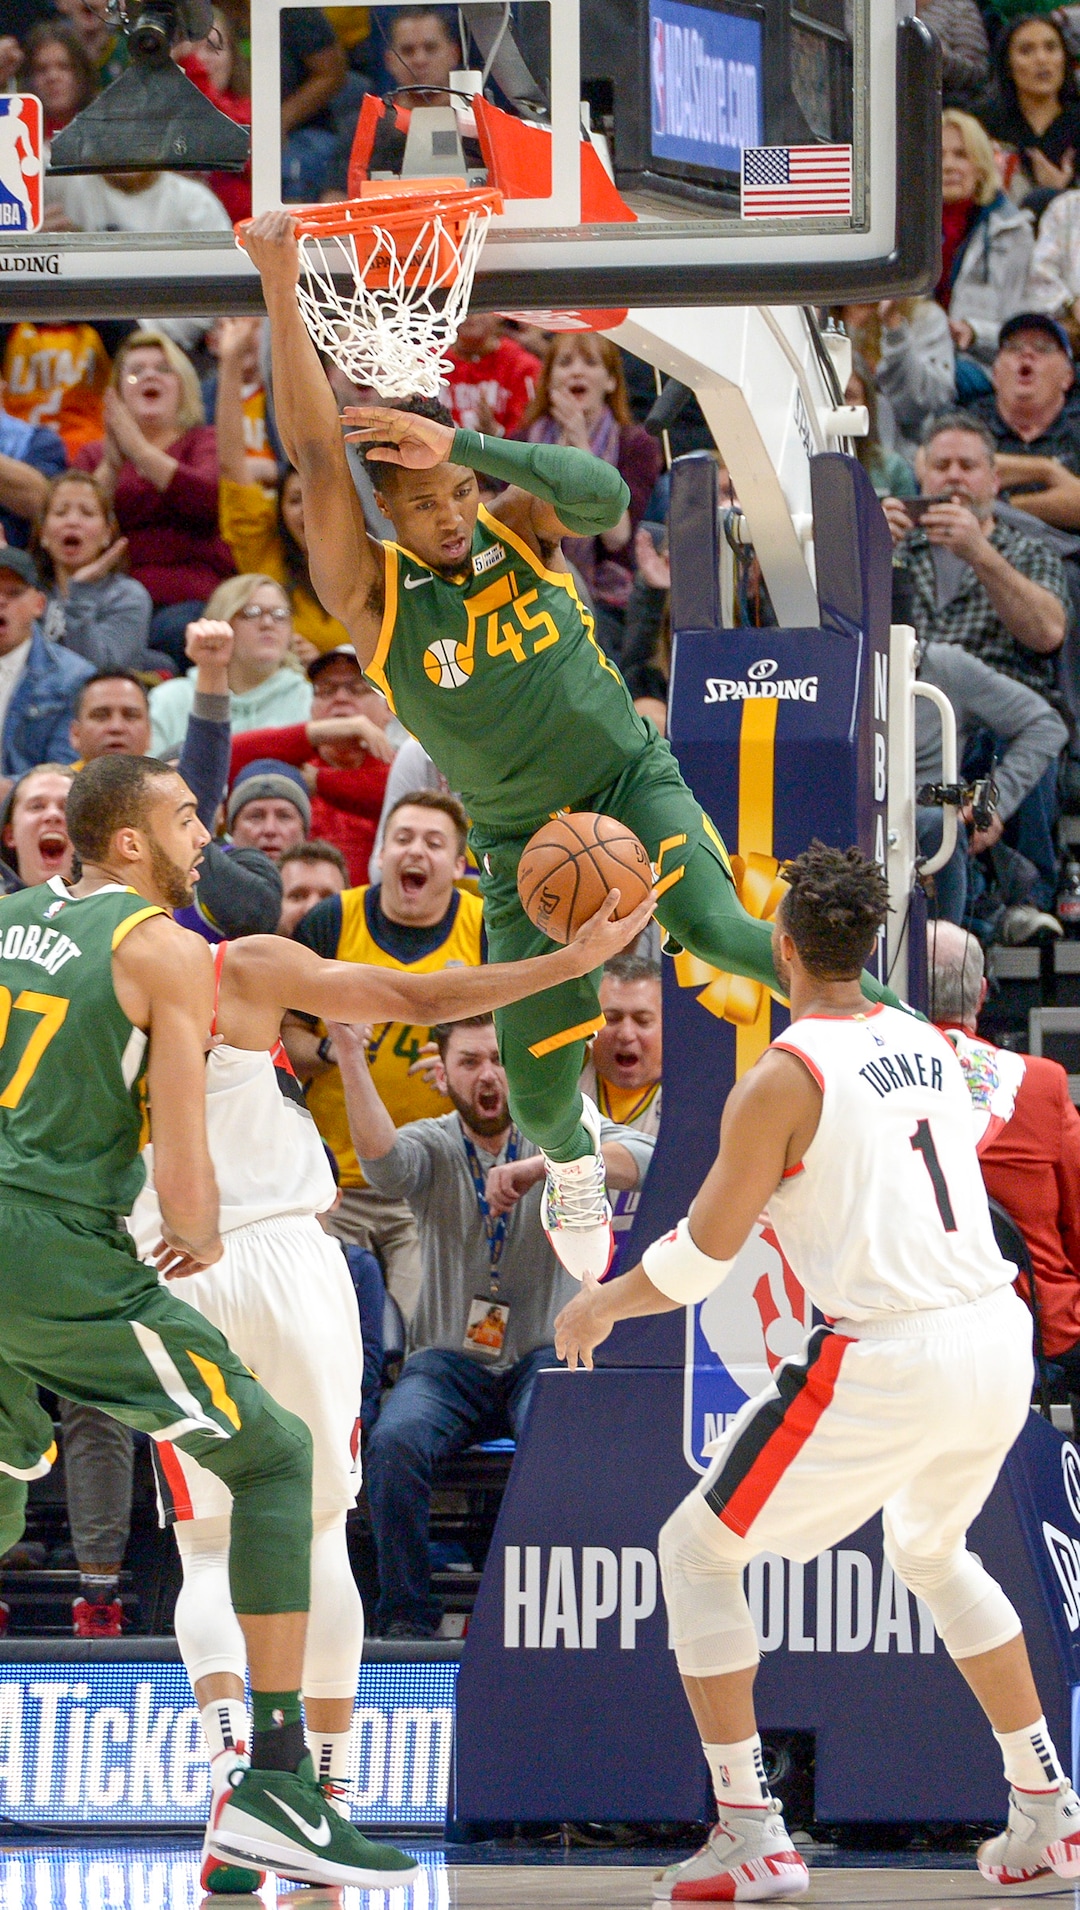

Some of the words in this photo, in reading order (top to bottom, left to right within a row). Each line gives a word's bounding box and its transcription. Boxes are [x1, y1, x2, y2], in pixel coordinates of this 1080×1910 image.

[664, 22, 759, 149] NBAStore.com
[0, 203, 21, 226] BA
[487, 588, 560, 664] 45
[704, 676, 818, 703] SPALDING
[0, 924, 82, 976] OBERT
[858, 1052, 943, 1099] TURNER
[908, 1117, 959, 1233] 1
[504, 1545, 675, 1651] HAPP
[748, 1548, 984, 1654] OLIDA
